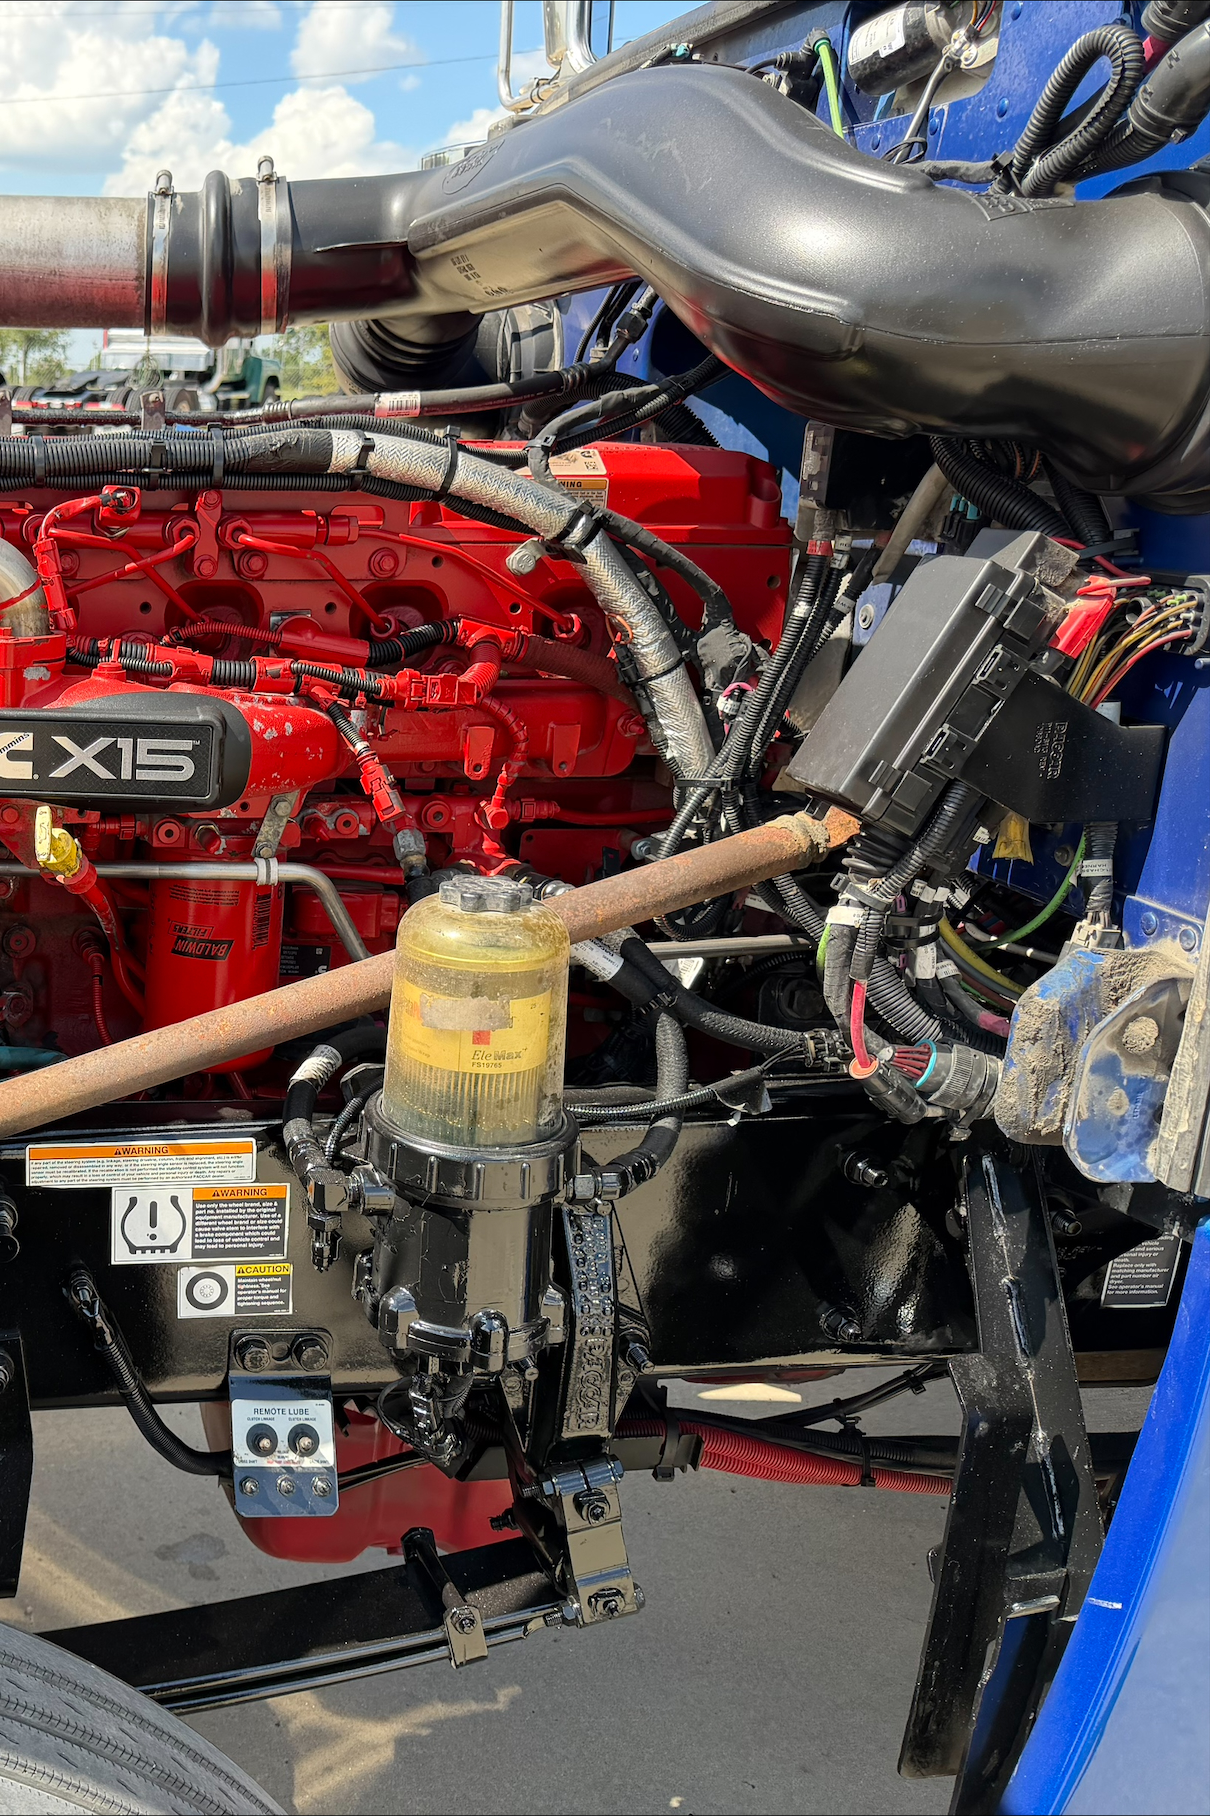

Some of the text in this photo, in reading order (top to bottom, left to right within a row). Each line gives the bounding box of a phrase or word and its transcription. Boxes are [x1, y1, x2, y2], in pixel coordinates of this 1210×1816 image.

[48, 736, 195, 782] X15
[173, 925, 208, 937] FILTERS
[175, 939, 229, 957] BALDWIN
[122, 1146, 169, 1155] WARNING
[246, 1265, 289, 1273] CAUTION
